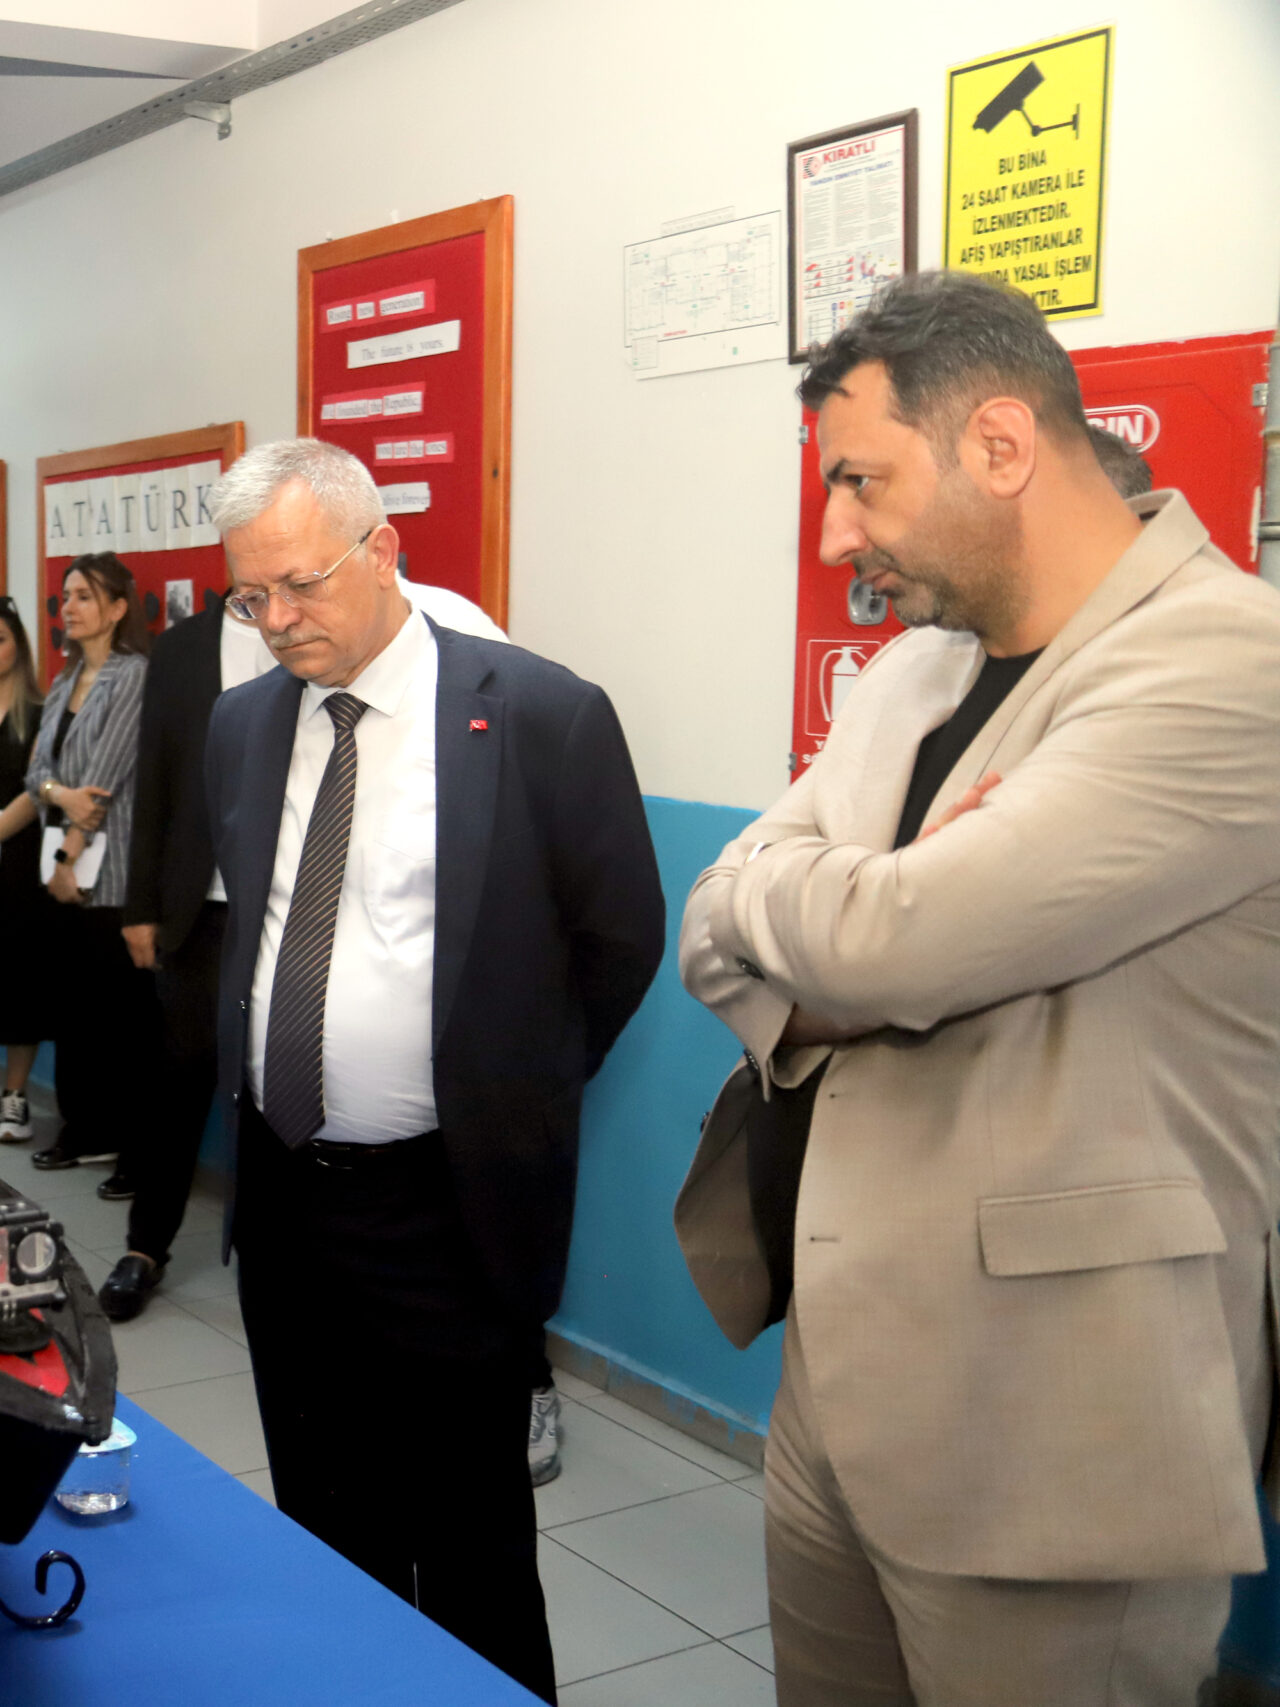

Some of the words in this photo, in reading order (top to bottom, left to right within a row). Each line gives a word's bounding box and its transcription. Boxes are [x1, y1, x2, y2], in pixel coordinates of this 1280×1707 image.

[823, 140, 876, 164] KIRATLI
[999, 156, 1015, 175] BU
[1018, 149, 1047, 171] BİNA
[962, 193, 975, 210] 24
[978, 185, 1008, 207] SAAT
[1011, 174, 1062, 201] KAMERA
[1066, 168, 1085, 189] İLE
[972, 200, 1071, 235] İZLENMEKTEDİR.
[960, 242, 985, 266] AFİŞ
[988, 227, 1083, 260] YAPIŞTIRANLAR
[1014, 261, 1051, 283] YASAL
[1054, 254, 1092, 281] İŞLEM
[50, 484, 214, 539] ATATÜRK
